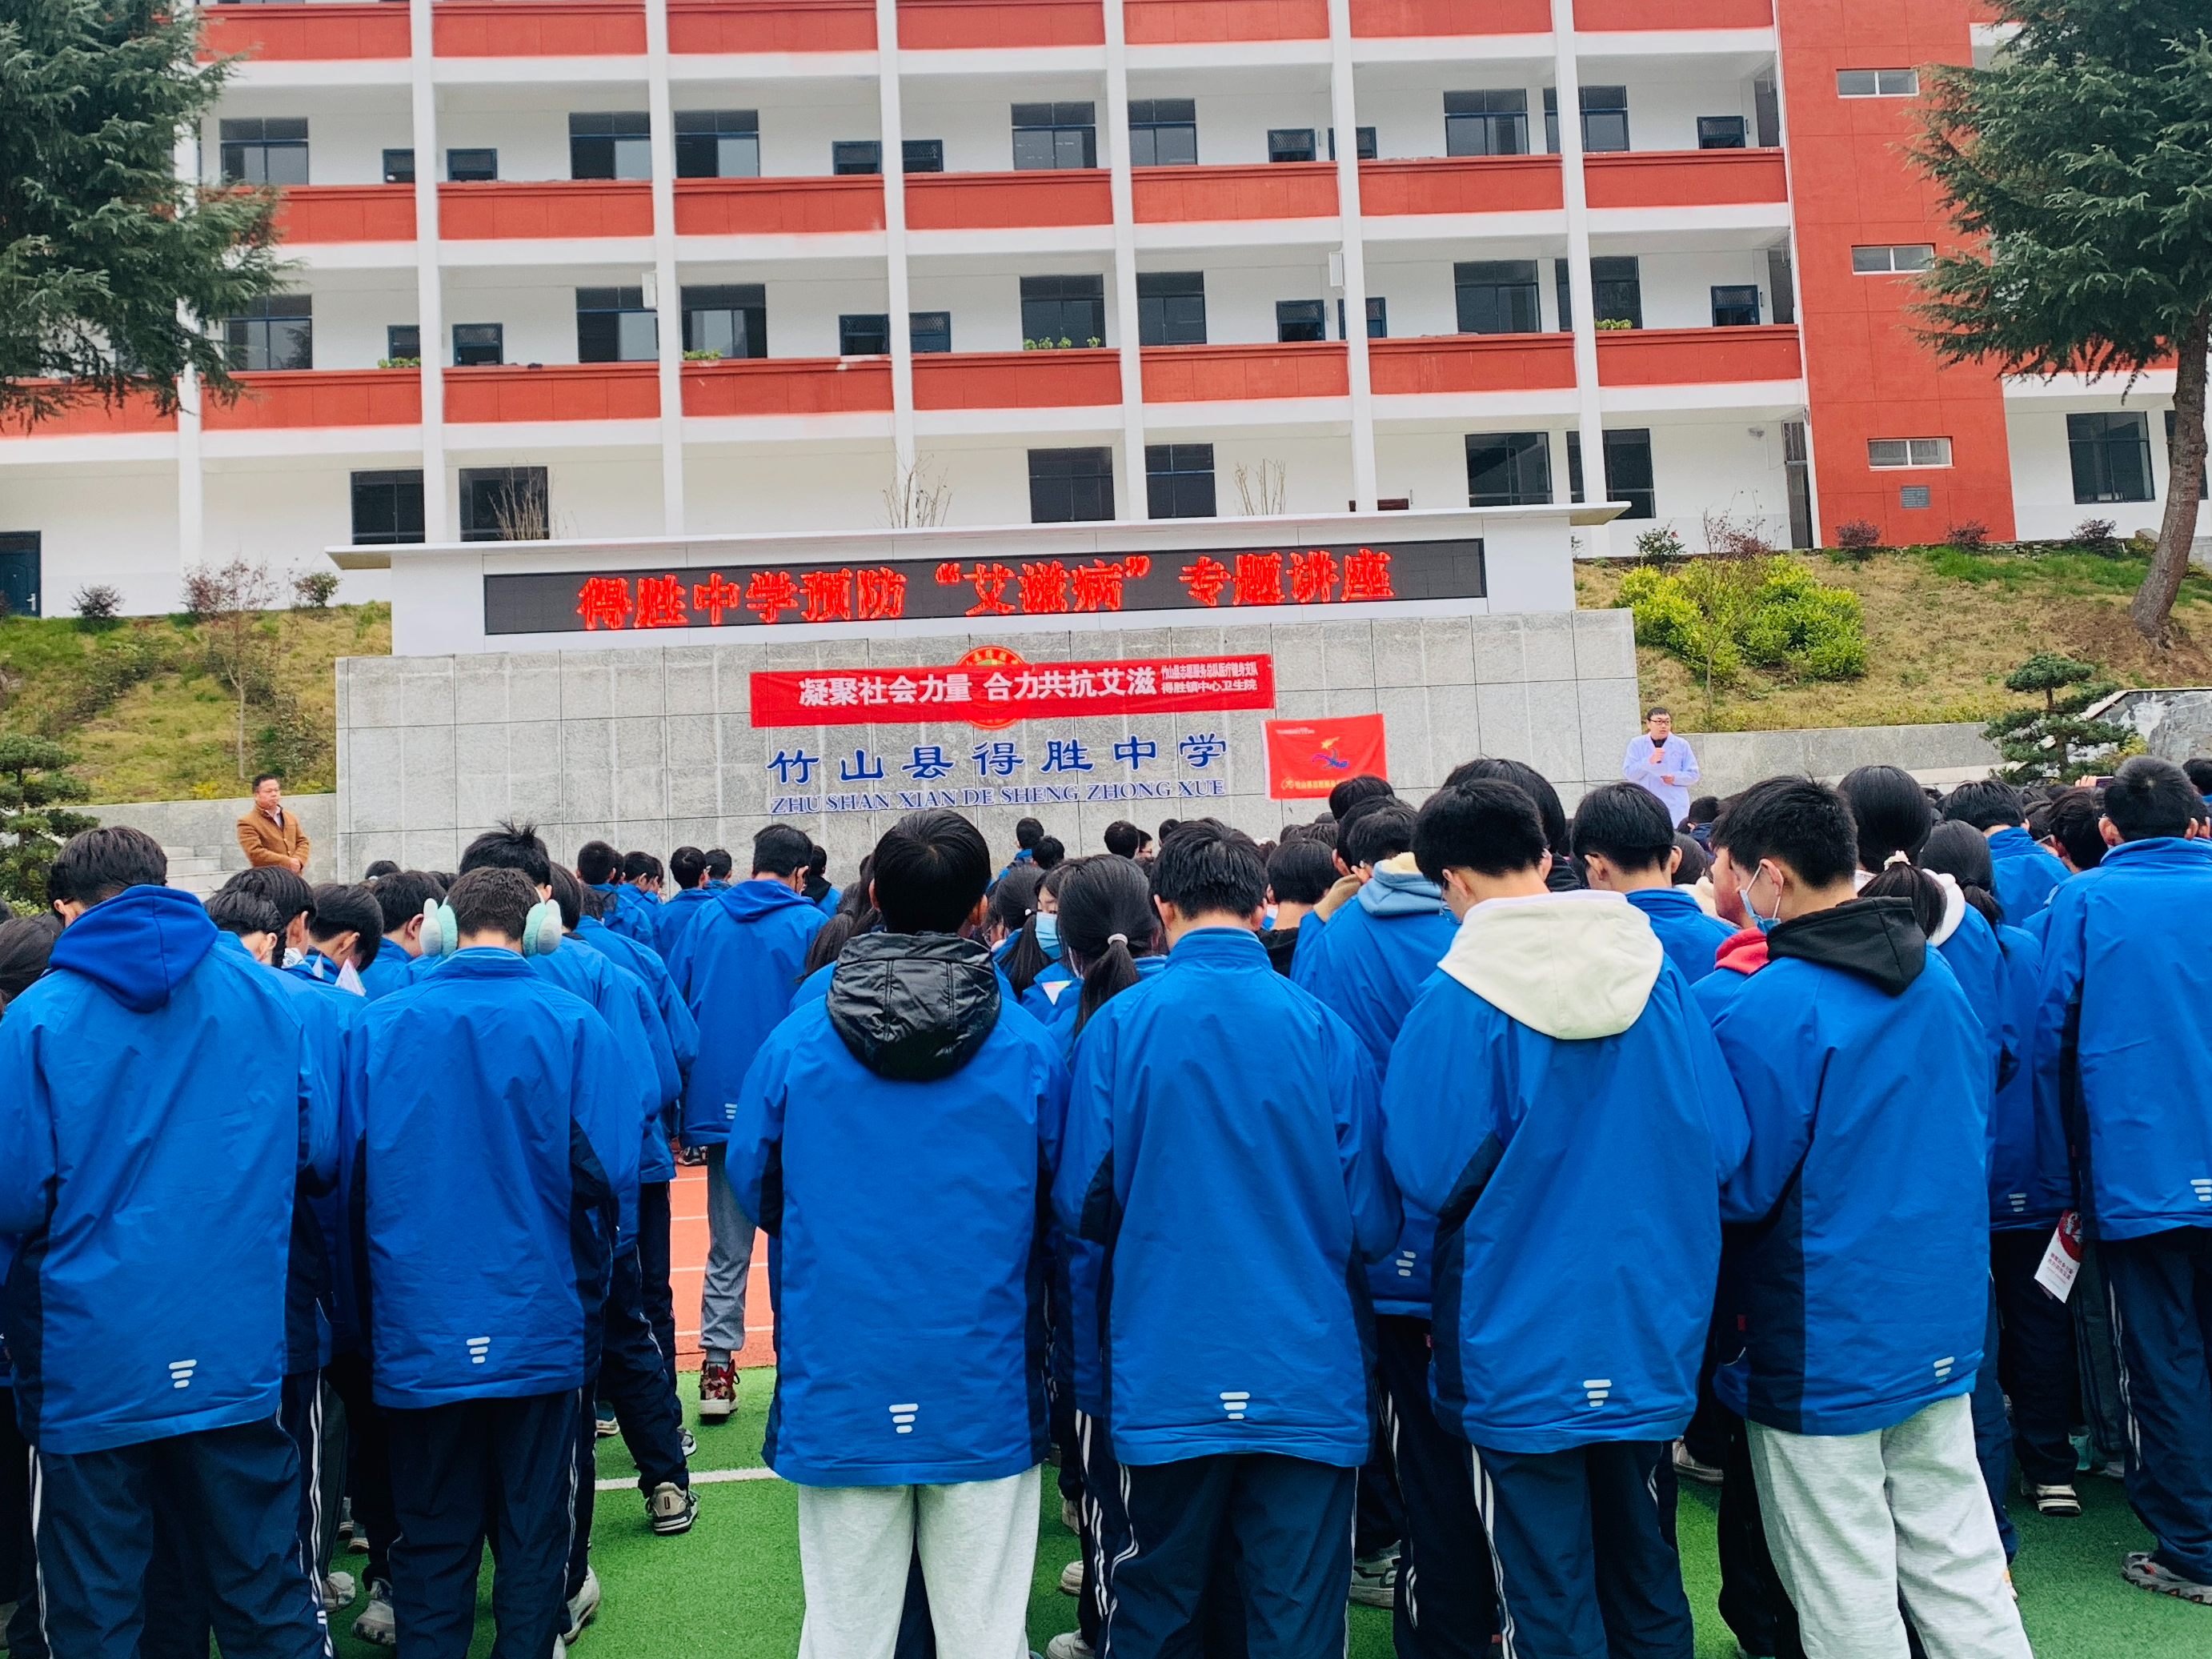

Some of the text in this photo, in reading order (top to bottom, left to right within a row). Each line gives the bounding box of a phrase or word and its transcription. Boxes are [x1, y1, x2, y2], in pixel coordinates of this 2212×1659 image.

[576, 567, 907, 631] 得胜中学预防
[1179, 548, 1394, 607] 专题讲座
[798, 666, 1157, 707] 凝聚社会力量 合力共抗艾滋
[1160, 679, 1258, 694] 得胜镇中心卫生院
[766, 732, 1227, 784] 竹山县得胜中学
[771, 779, 1225, 814] ZHU SHAN XIAN DE SHENG ZHONG XUE
